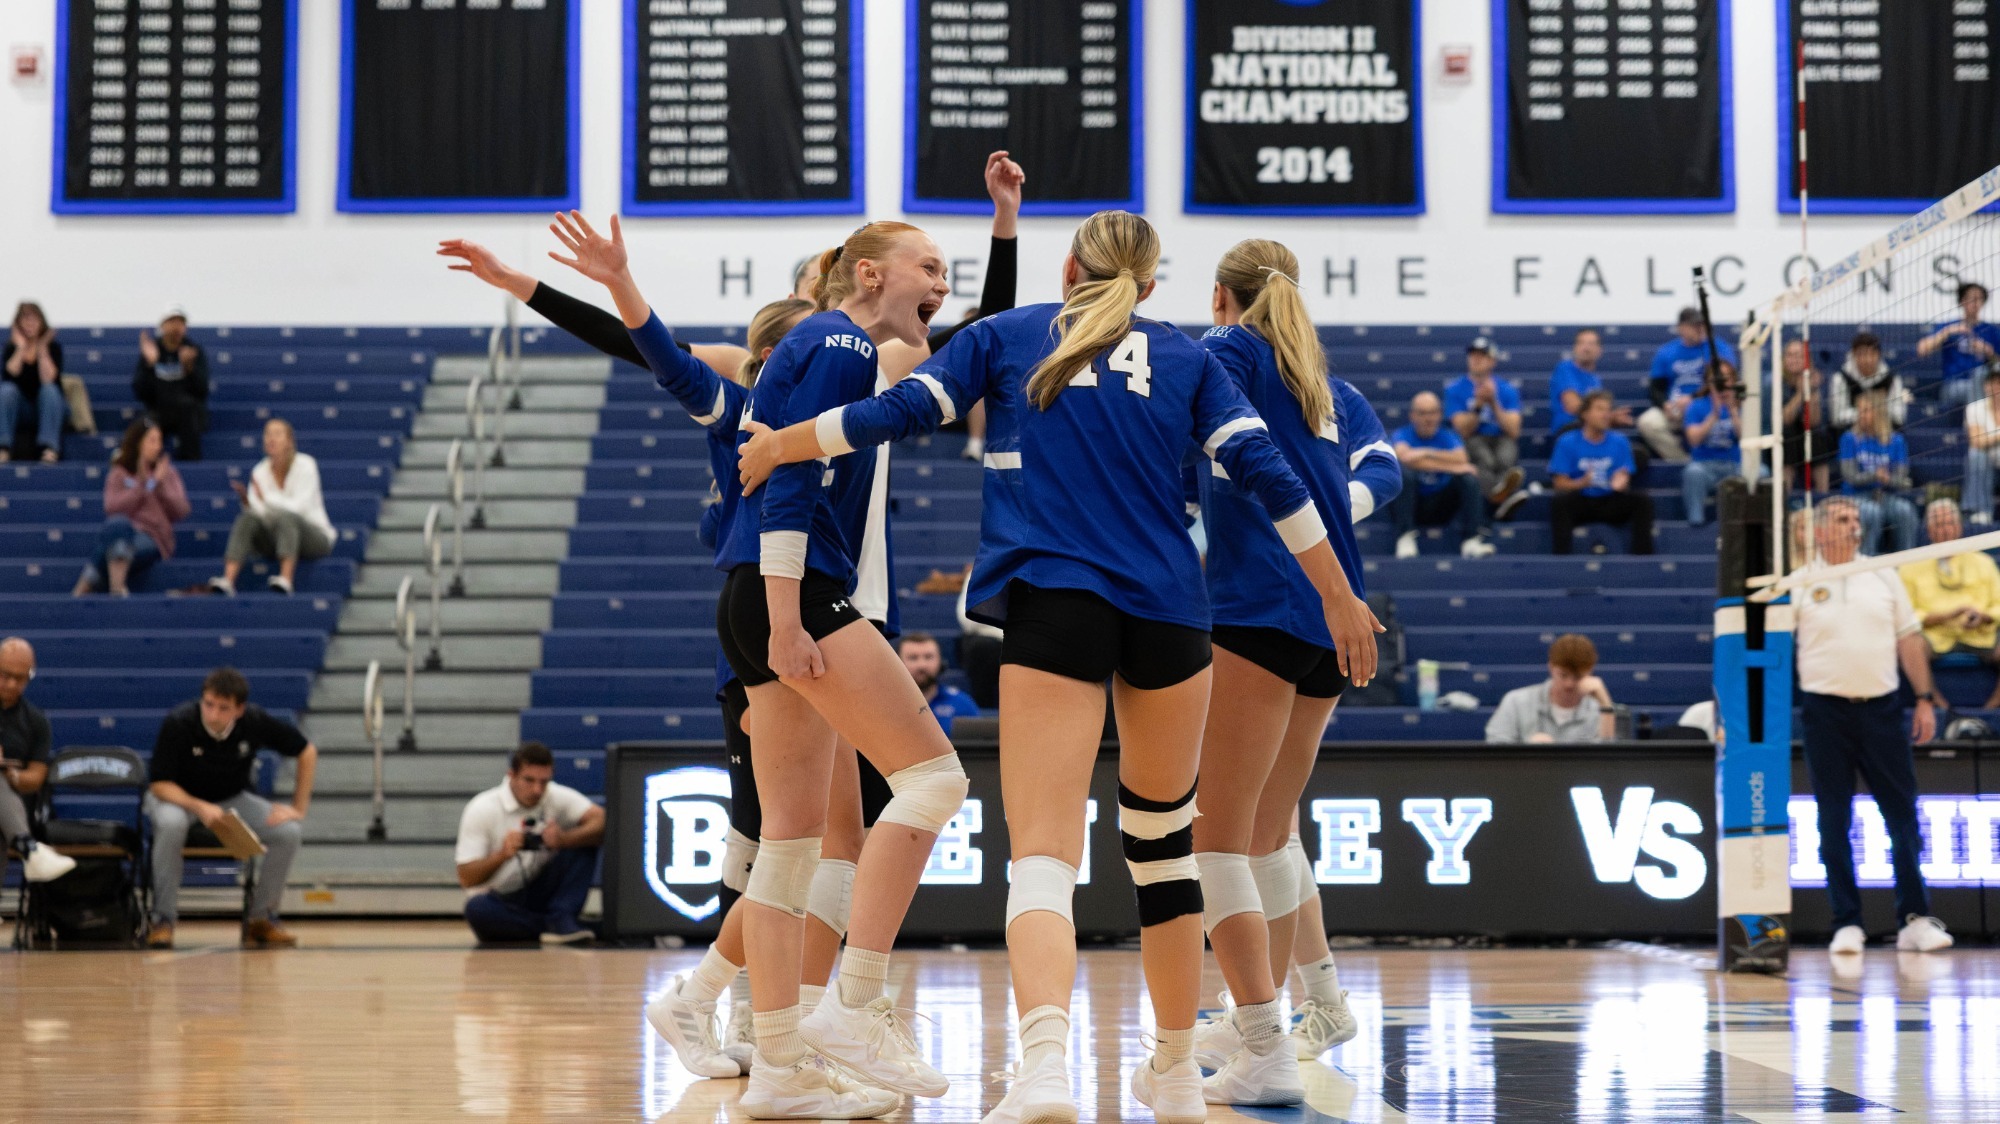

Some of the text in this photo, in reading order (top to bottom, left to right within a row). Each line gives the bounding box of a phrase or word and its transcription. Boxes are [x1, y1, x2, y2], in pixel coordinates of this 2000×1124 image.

[1233, 26, 1375, 51] DIVISION II
[1212, 54, 1397, 87] NATIONAL
[1200, 90, 1409, 123] CHAMPIONS
[1257, 146, 1352, 183] 2014
[825, 334, 873, 359] NE10
[1749, 771, 1767, 825] sports
[660, 800, 730, 885] B
